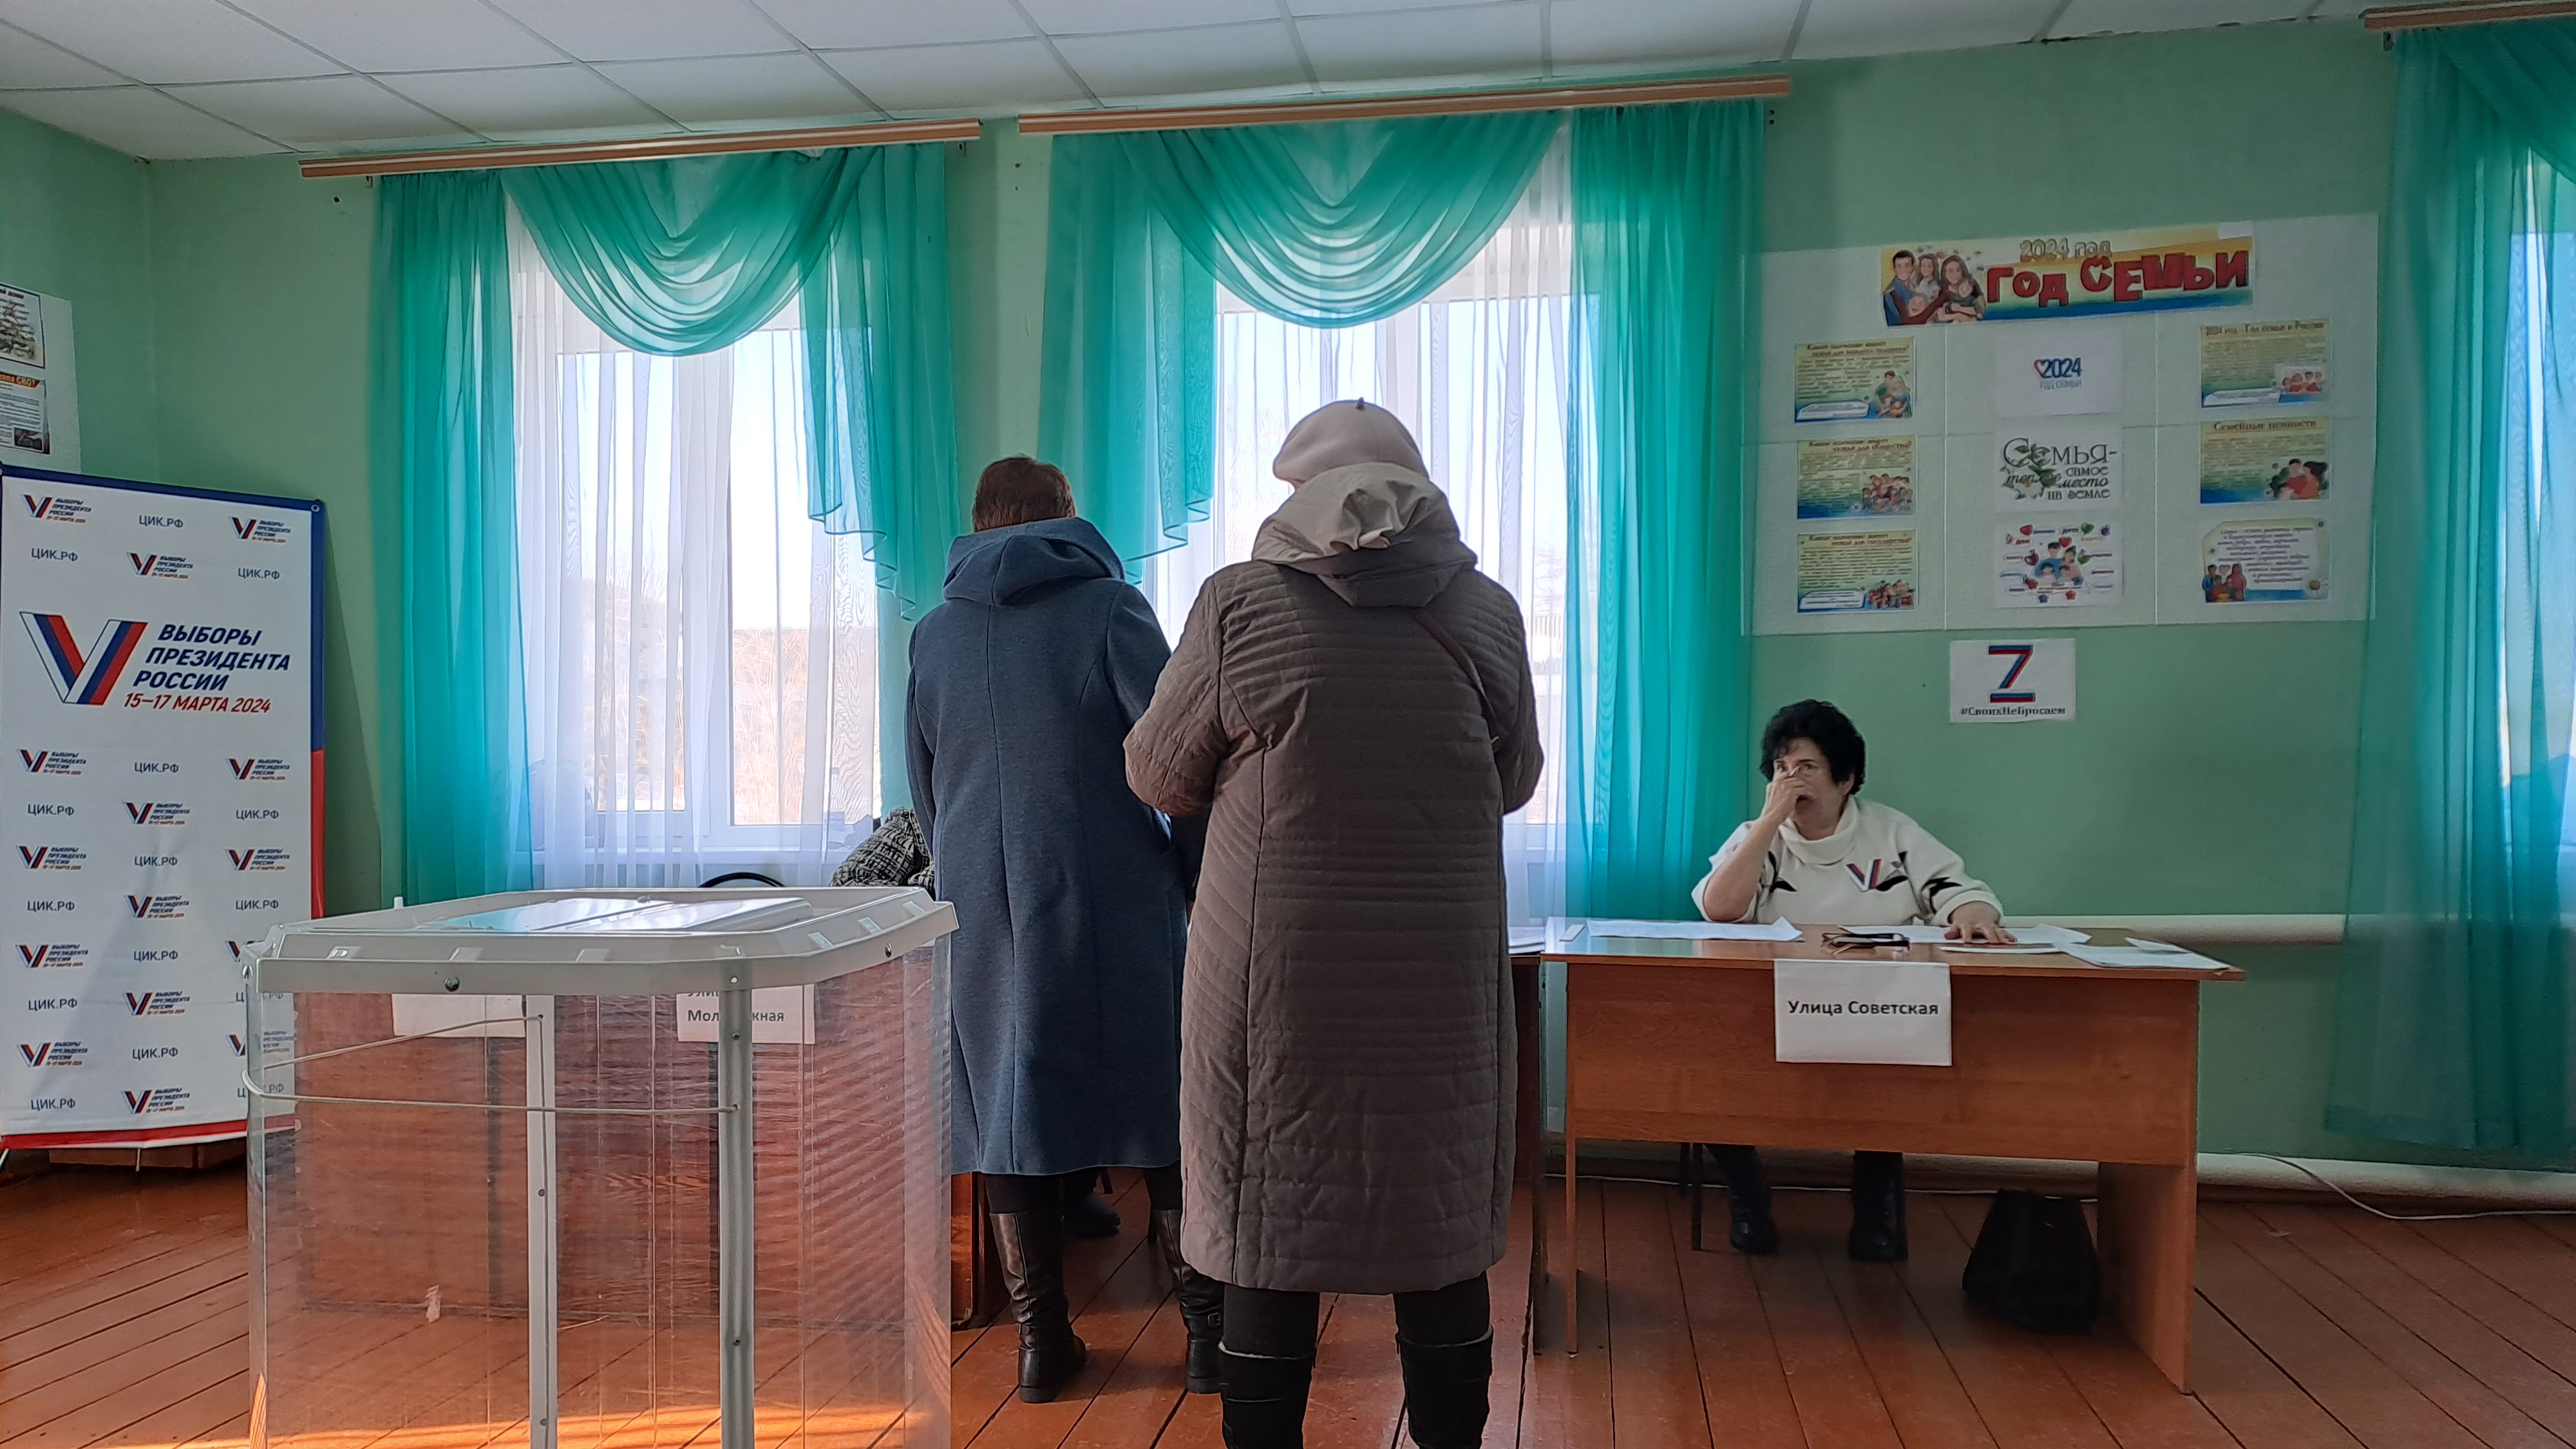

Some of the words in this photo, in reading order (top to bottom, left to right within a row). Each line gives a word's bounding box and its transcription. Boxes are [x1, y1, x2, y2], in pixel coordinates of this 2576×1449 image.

[2020, 237, 2070, 263] 2024
[2040, 357, 2083, 379] 2024
[139, 515, 184, 528] ЦИК.РФ
[31, 548, 78, 562] ЦИК.РФ
[238, 567, 280, 580] ЦИК.РФ
[157, 624, 263, 646] ВЫБОРЫ
[145, 647, 291, 671] ПРЕЗИДЕНТА
[132, 670, 230, 691] РОССИИ
[1988, 645, 2036, 703] Z
[171, 695, 229, 712] МАРТА
[231, 697, 271, 714] 2024
[134, 762, 178, 774] ЦИК.РФ
[28, 804, 75, 816] ЦИК.РФ
[236, 810, 279, 820] ЦИК.РФ
[134, 856, 178, 867] ЦИК.РФ
[27, 900, 75, 913] ЦИК.РФ
[235, 900, 279, 911] ЦИК.РФ
[133, 950, 178, 962] ЦИК.РФ
[28, 998, 77, 1012] ЦИК.РФ
[1788, 1001, 1842, 1016] Улица
[1848, 1001, 1938, 1015] Советская
[132, 1047, 178, 1061] ЦИК.РФ
[31, 1097, 75, 1112] ЦИК.РФ
